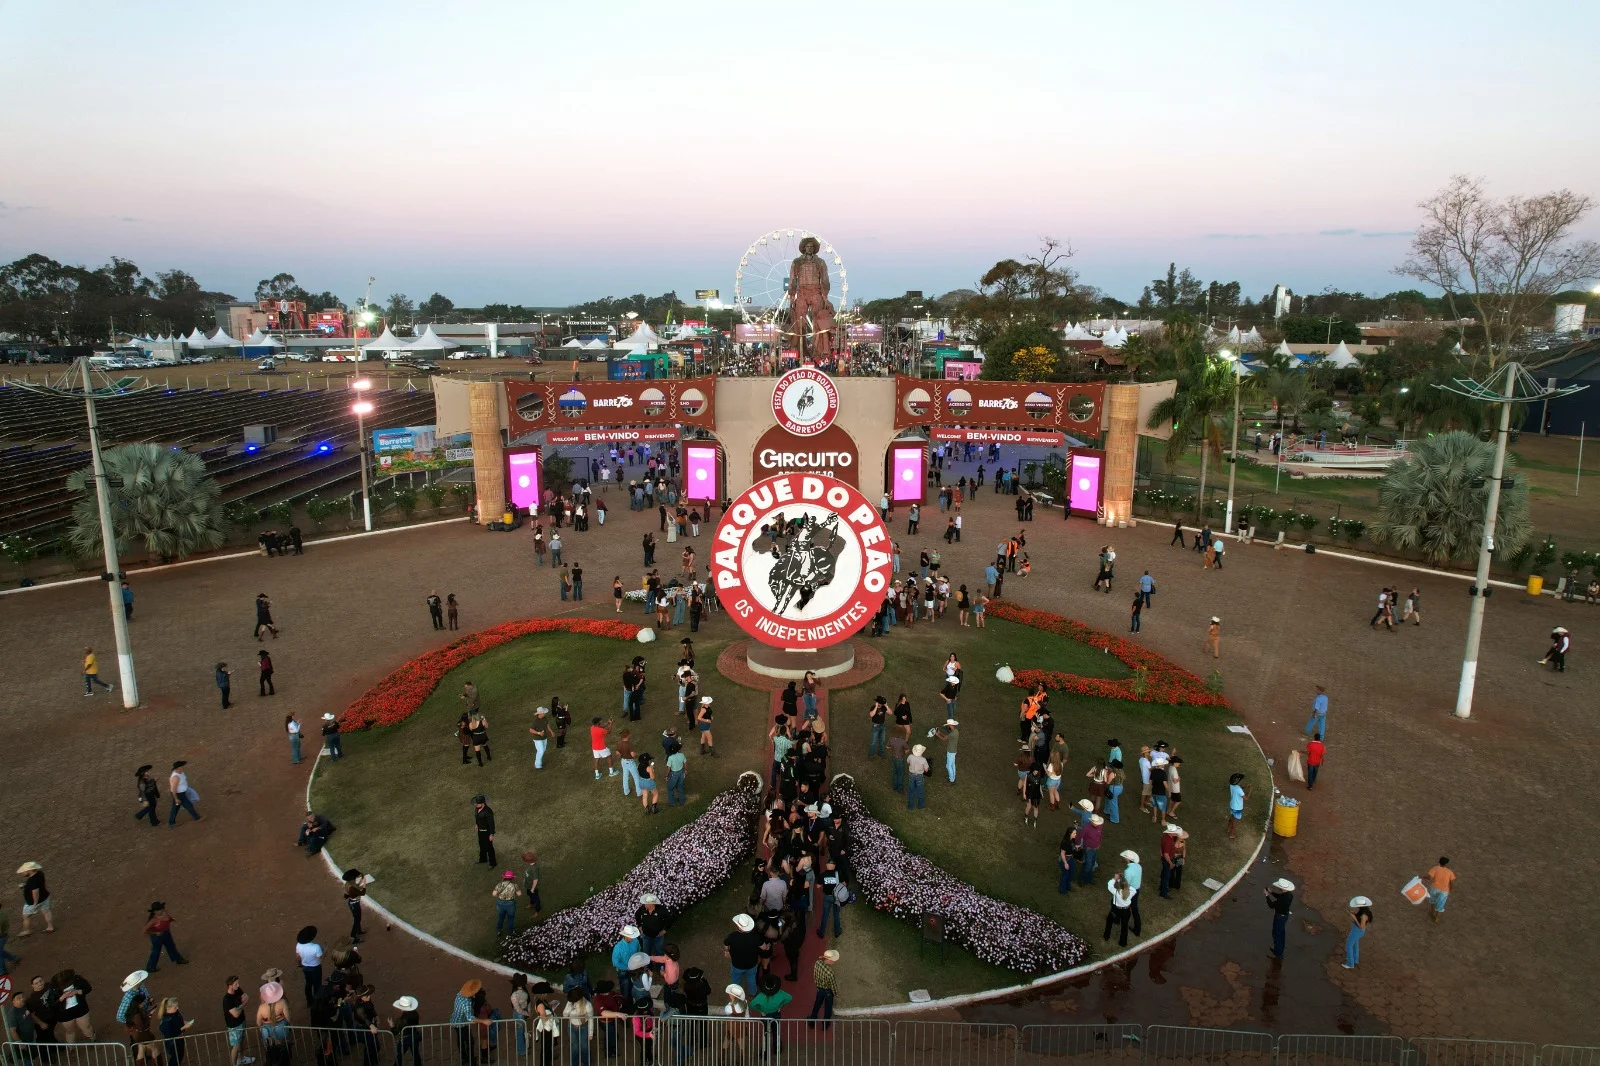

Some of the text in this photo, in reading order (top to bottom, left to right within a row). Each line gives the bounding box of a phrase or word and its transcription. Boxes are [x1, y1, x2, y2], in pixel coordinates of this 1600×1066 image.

[774, 370, 837, 410] FESTA DO PEÃO DE BOIADEIRO
[584, 431, 640, 441] BEM-VINDO
[785, 419, 827, 434] BARRETOS
[966, 432, 1022, 442] BEM-VINDO
[759, 448, 852, 469] CIRCUITO
[715, 476, 892, 593] PARQUE DO PEÃO
[734, 599, 868, 642] OS INDEPENDENTES
